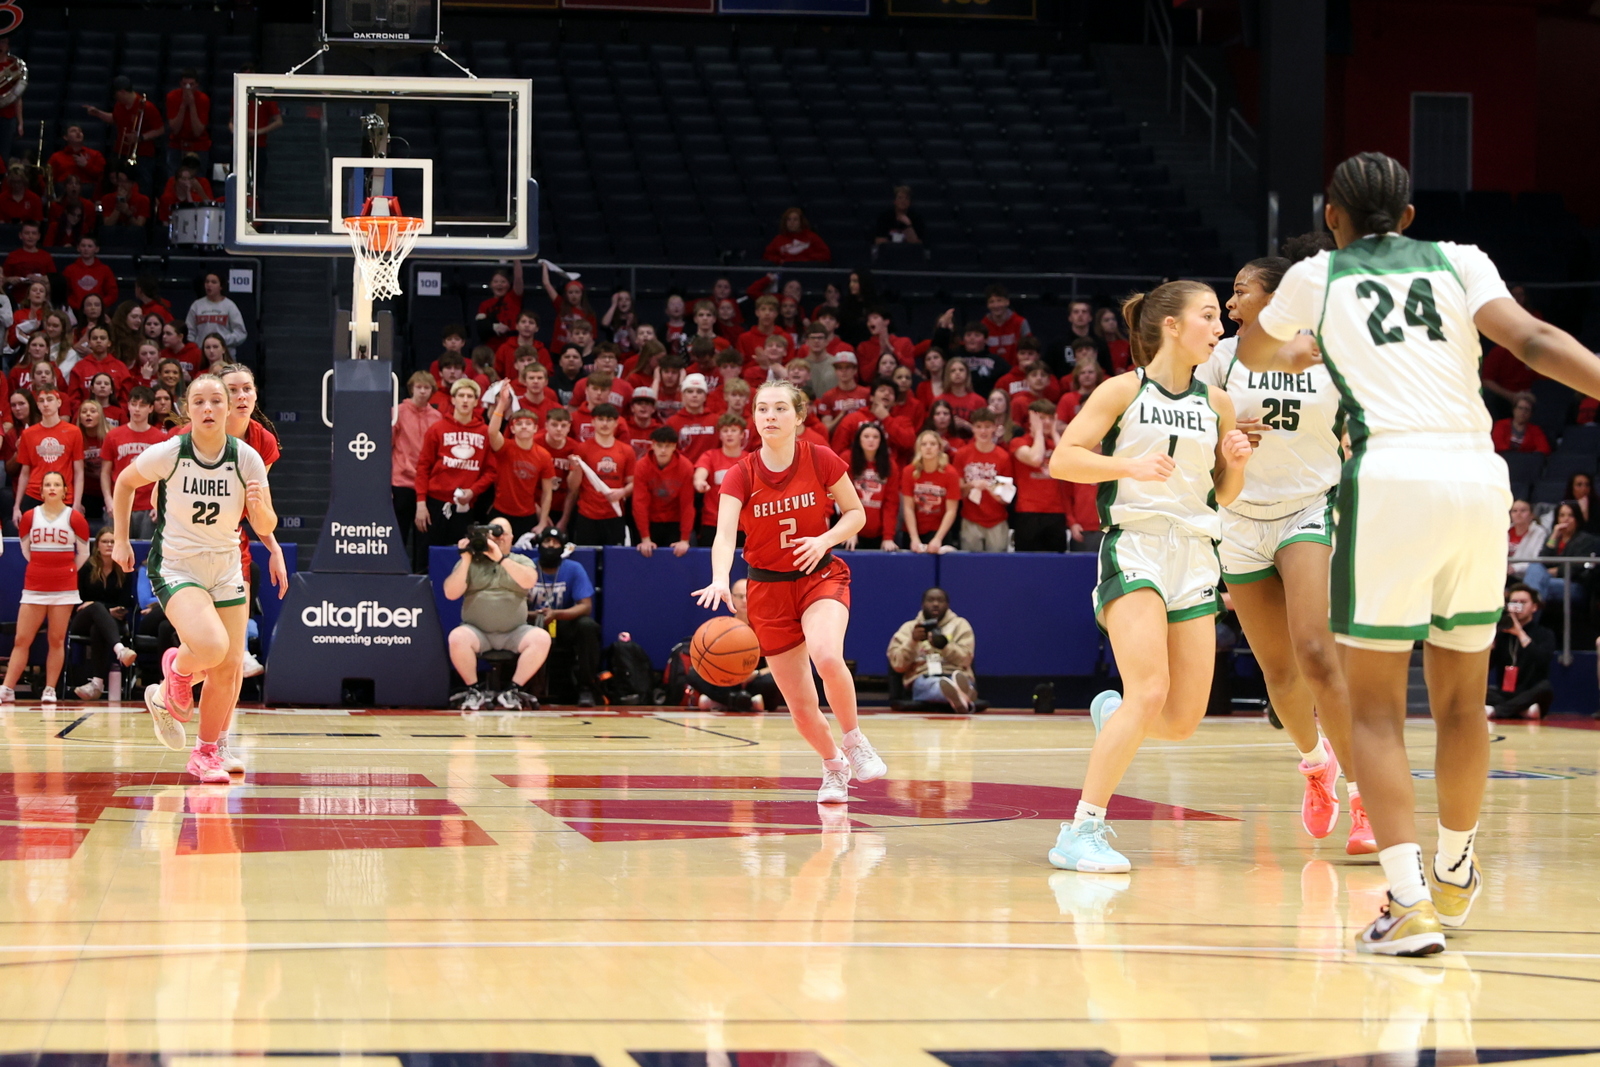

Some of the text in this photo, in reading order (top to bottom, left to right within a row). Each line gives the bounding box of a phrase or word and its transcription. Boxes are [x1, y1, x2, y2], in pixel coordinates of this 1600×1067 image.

[232, 277, 250, 286] 108
[420, 279, 438, 288] 109
[1355, 277, 1447, 346] 24
[1248, 371, 1317, 393] LAUREL
[1140, 402, 1206, 432] LAUREL
[1262, 397, 1301, 431] 25
[443, 431, 486, 449] BELLEVUE
[1168, 434, 1178, 458] 1
[442, 455, 480, 471] FOOTBALL
[183, 476, 231, 496] LAUREL
[192, 501, 220, 526] 22
[753, 491, 816, 518] BELLEVUE
[283, 517, 301, 527] 108
[331, 522, 393, 538] Premier
[32, 527, 69, 545] BHS
[778, 517, 797, 549] 2
[335, 539, 388, 555] Health
[301, 600, 424, 633] altafiber
[312, 634, 411, 646] connecting dayton
